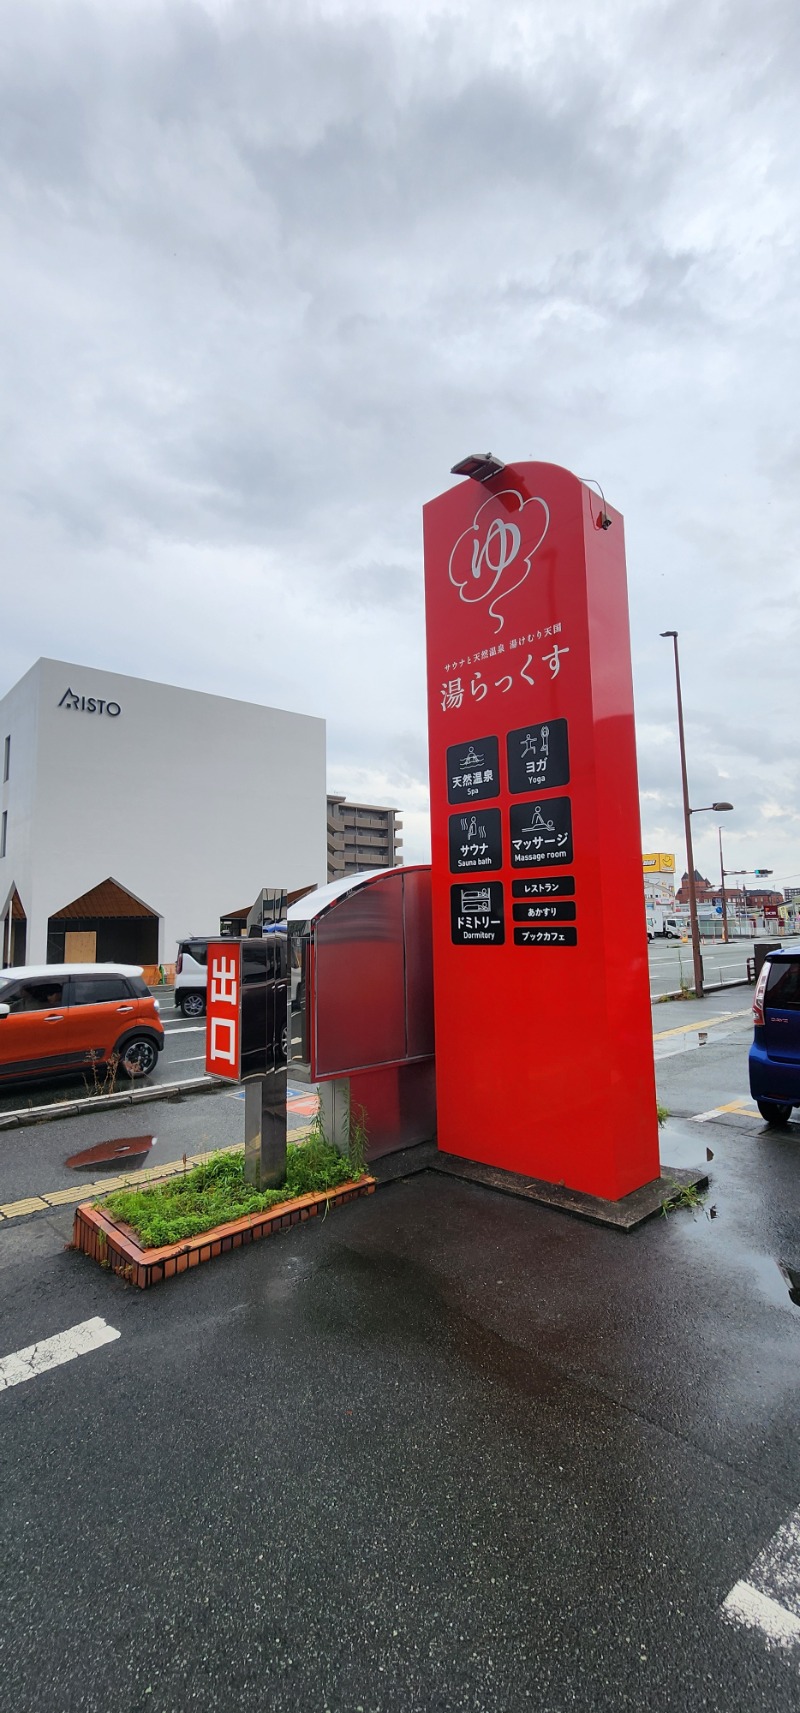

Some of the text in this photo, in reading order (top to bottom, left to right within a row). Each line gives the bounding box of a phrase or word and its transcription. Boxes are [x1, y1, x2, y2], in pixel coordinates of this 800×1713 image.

[471, 518, 521, 578] ゆ
[444, 622, 562, 673] サウナと天然温泉 湯けむり天国
[440, 644, 570, 712] 湯らっくす
[57, 687, 121, 716] ARISTO
[525, 757, 548, 774] ヨガ
[452, 769, 494, 789] 天然温泉
[528, 775, 546, 784] Yoga
[467, 787, 479, 796] Spa
[512, 832, 568, 851] マッサージ
[460, 842, 489, 857] サウナ
[514, 850, 567, 862] Massage room
[457, 856, 492, 867] Sauna bath
[524, 883, 559, 893] レストラン
[527, 907, 557, 917] あかすり
[457, 916, 501, 929] ドミトリー
[463, 931, 495, 941] Dormitory
[521, 931, 566, 941] ブックカフェ
[210, 956, 237, 1066] 出口
